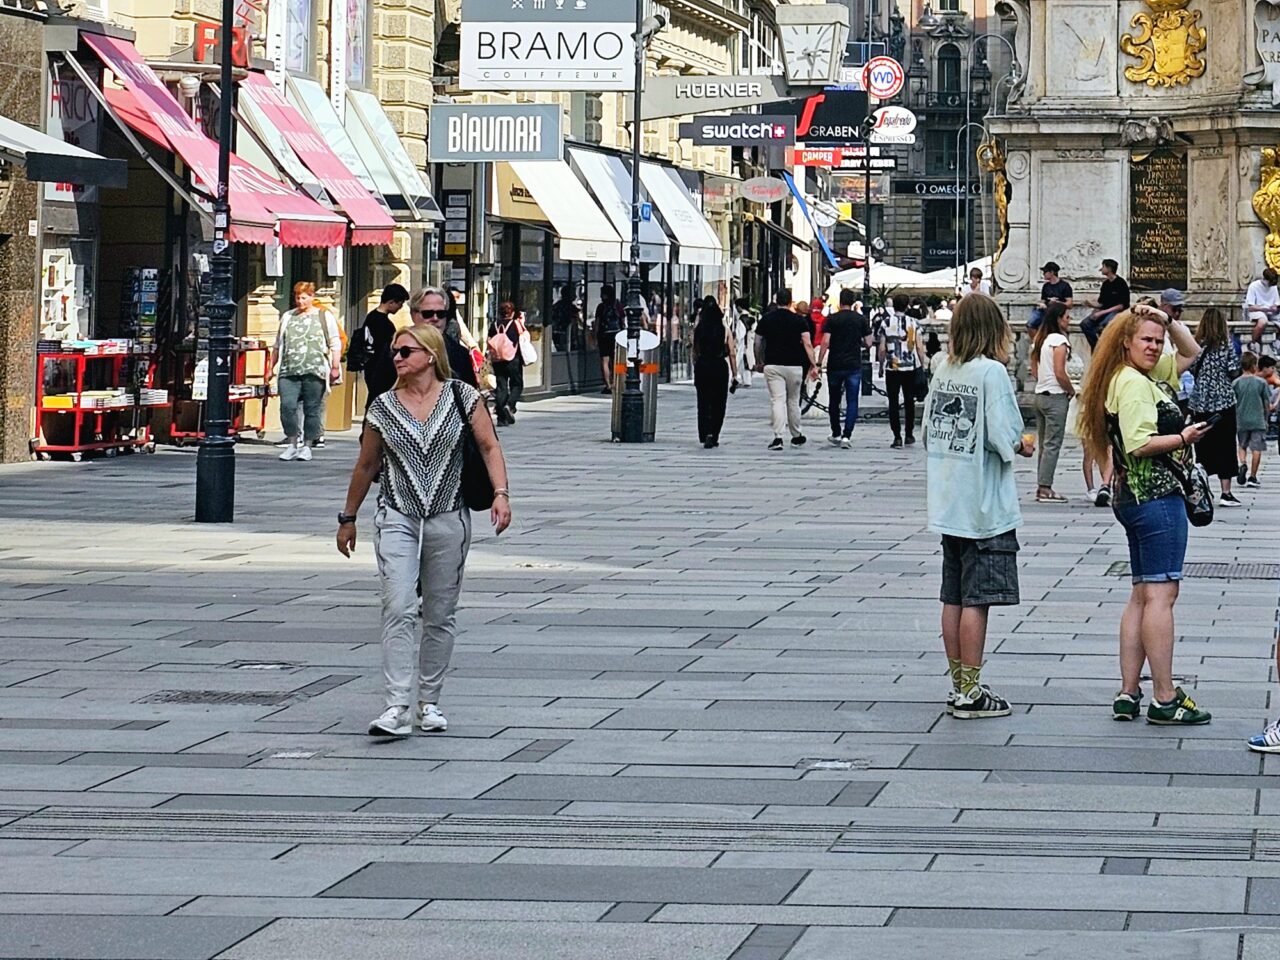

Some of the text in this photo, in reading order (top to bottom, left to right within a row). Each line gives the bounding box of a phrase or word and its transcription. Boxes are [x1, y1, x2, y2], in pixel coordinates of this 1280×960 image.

[477, 31, 624, 60] BRAMO
[483, 71, 618, 80] COIFFEUR
[675, 82, 762, 98] HÜBNER
[702, 122, 772, 139] swatch
[809, 125, 861, 138] GRABEN
[801, 151, 833, 163] CAMPER
[929, 184, 966, 194] OMEGA
